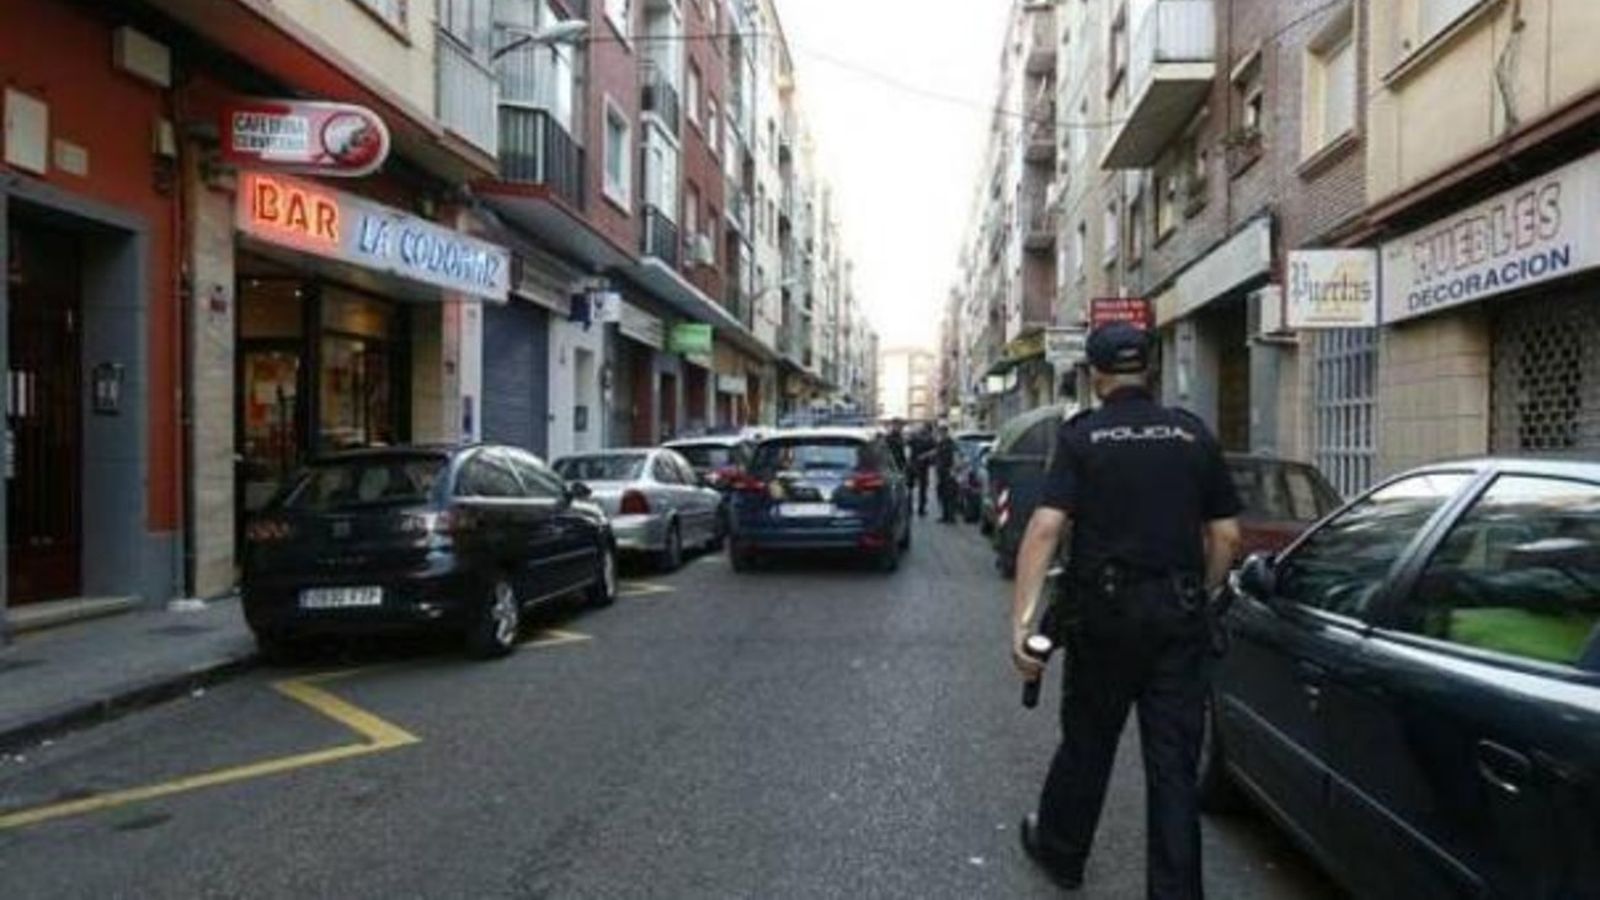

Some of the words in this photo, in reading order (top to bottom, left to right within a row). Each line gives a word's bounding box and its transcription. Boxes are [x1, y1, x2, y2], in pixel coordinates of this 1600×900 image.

[252, 181, 338, 240] BAR
[358, 214, 388, 257] LA
[1407, 244, 1570, 311] DECORACION
[1091, 424, 1189, 443] POLICIA
